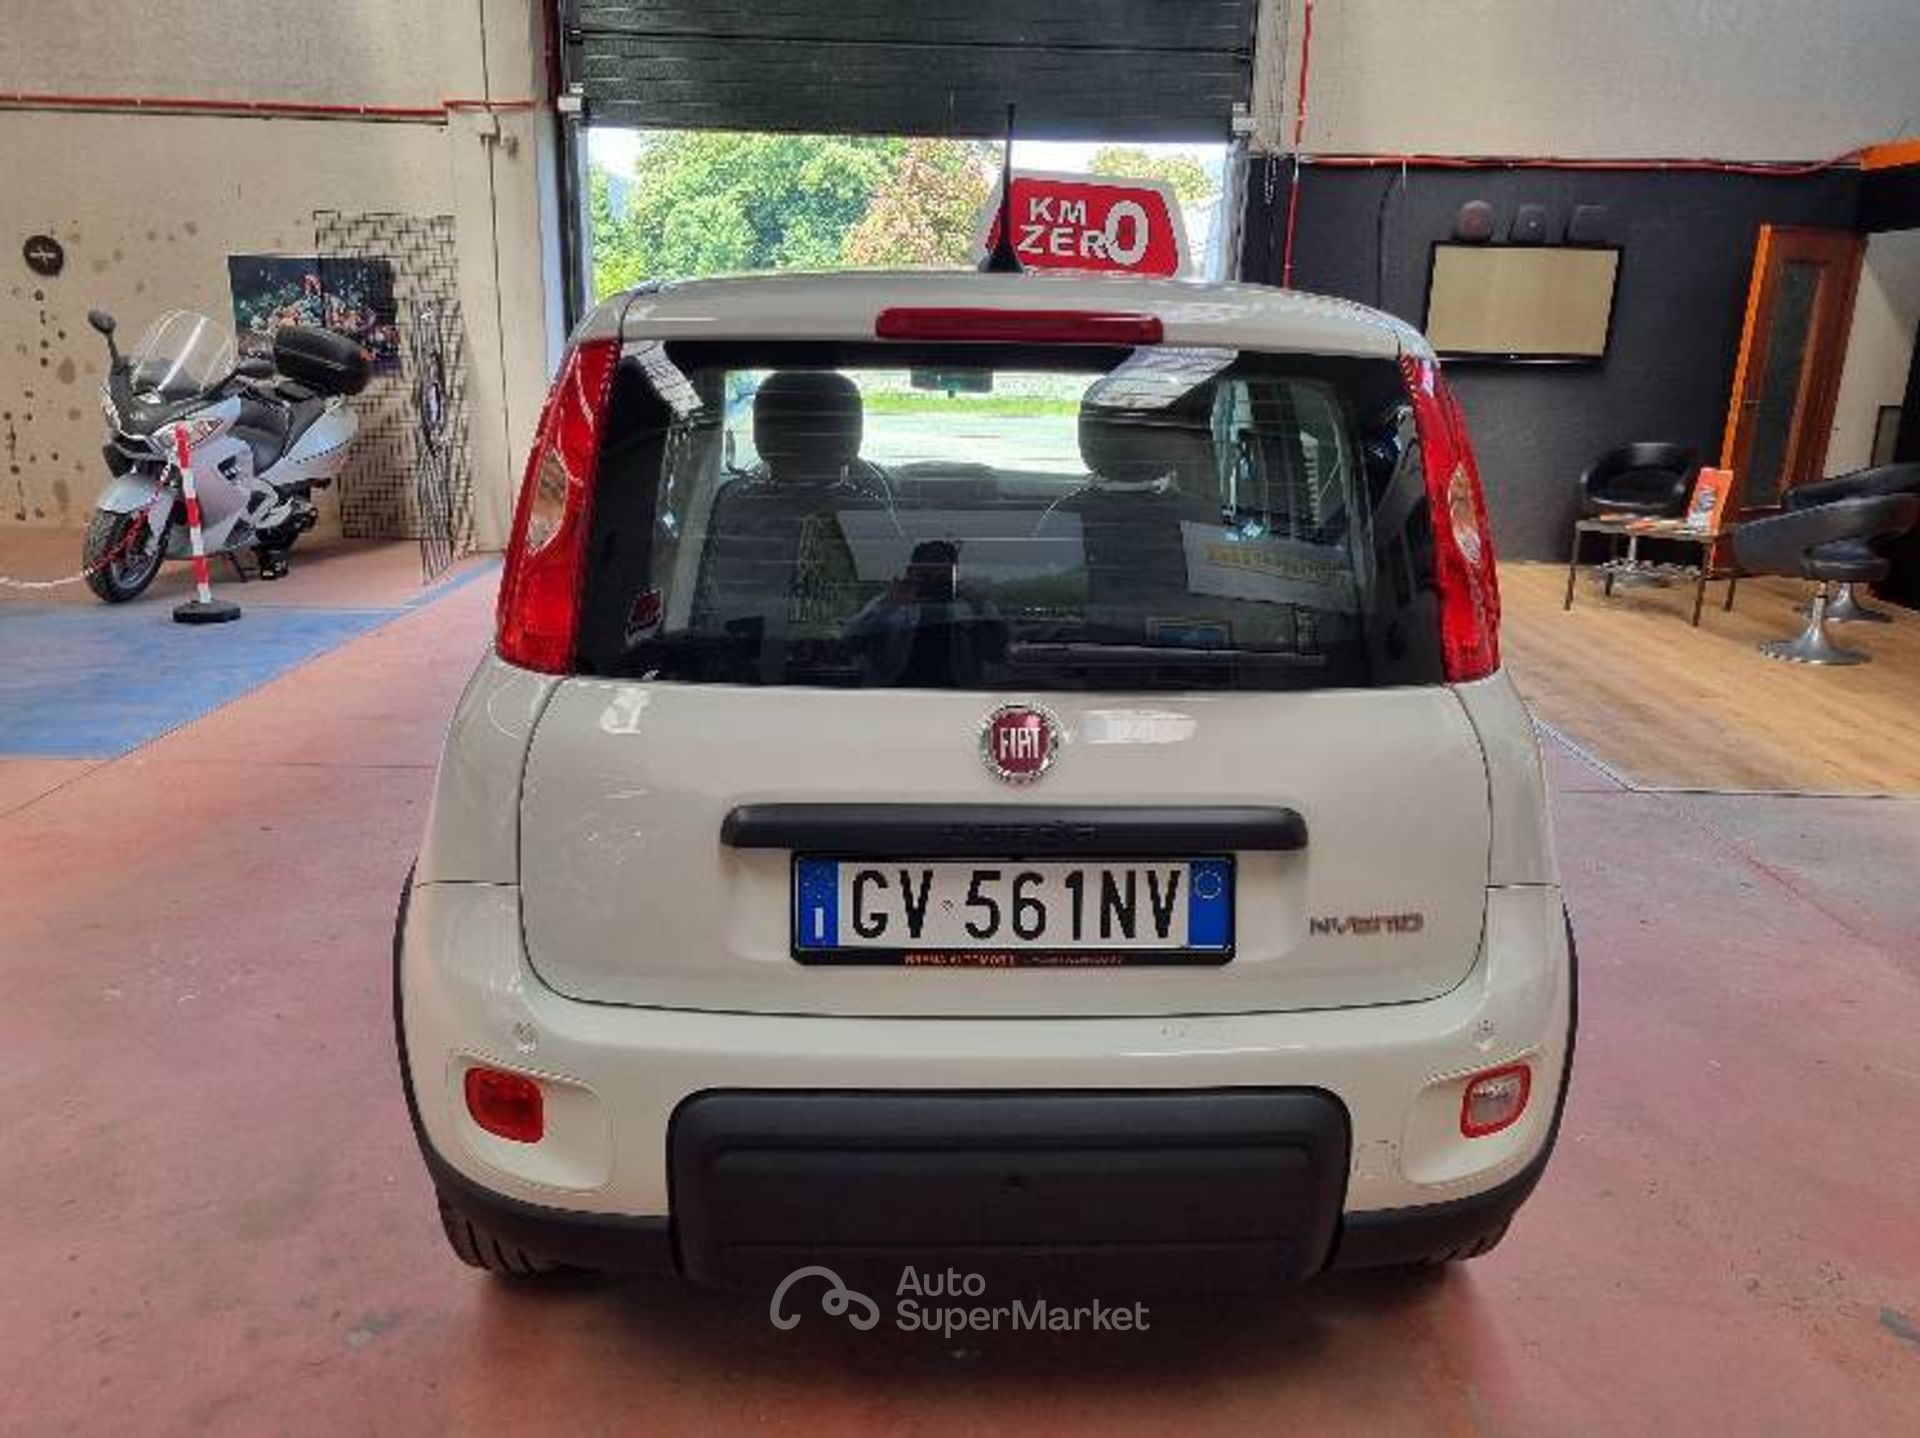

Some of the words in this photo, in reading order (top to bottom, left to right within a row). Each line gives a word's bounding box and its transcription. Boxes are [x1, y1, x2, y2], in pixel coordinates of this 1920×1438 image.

[1029, 197, 1087, 225] KM
[1000, 727, 1040, 759] FIAT
[852, 870, 933, 939] GV
[964, 869, 1181, 940] 561NV
